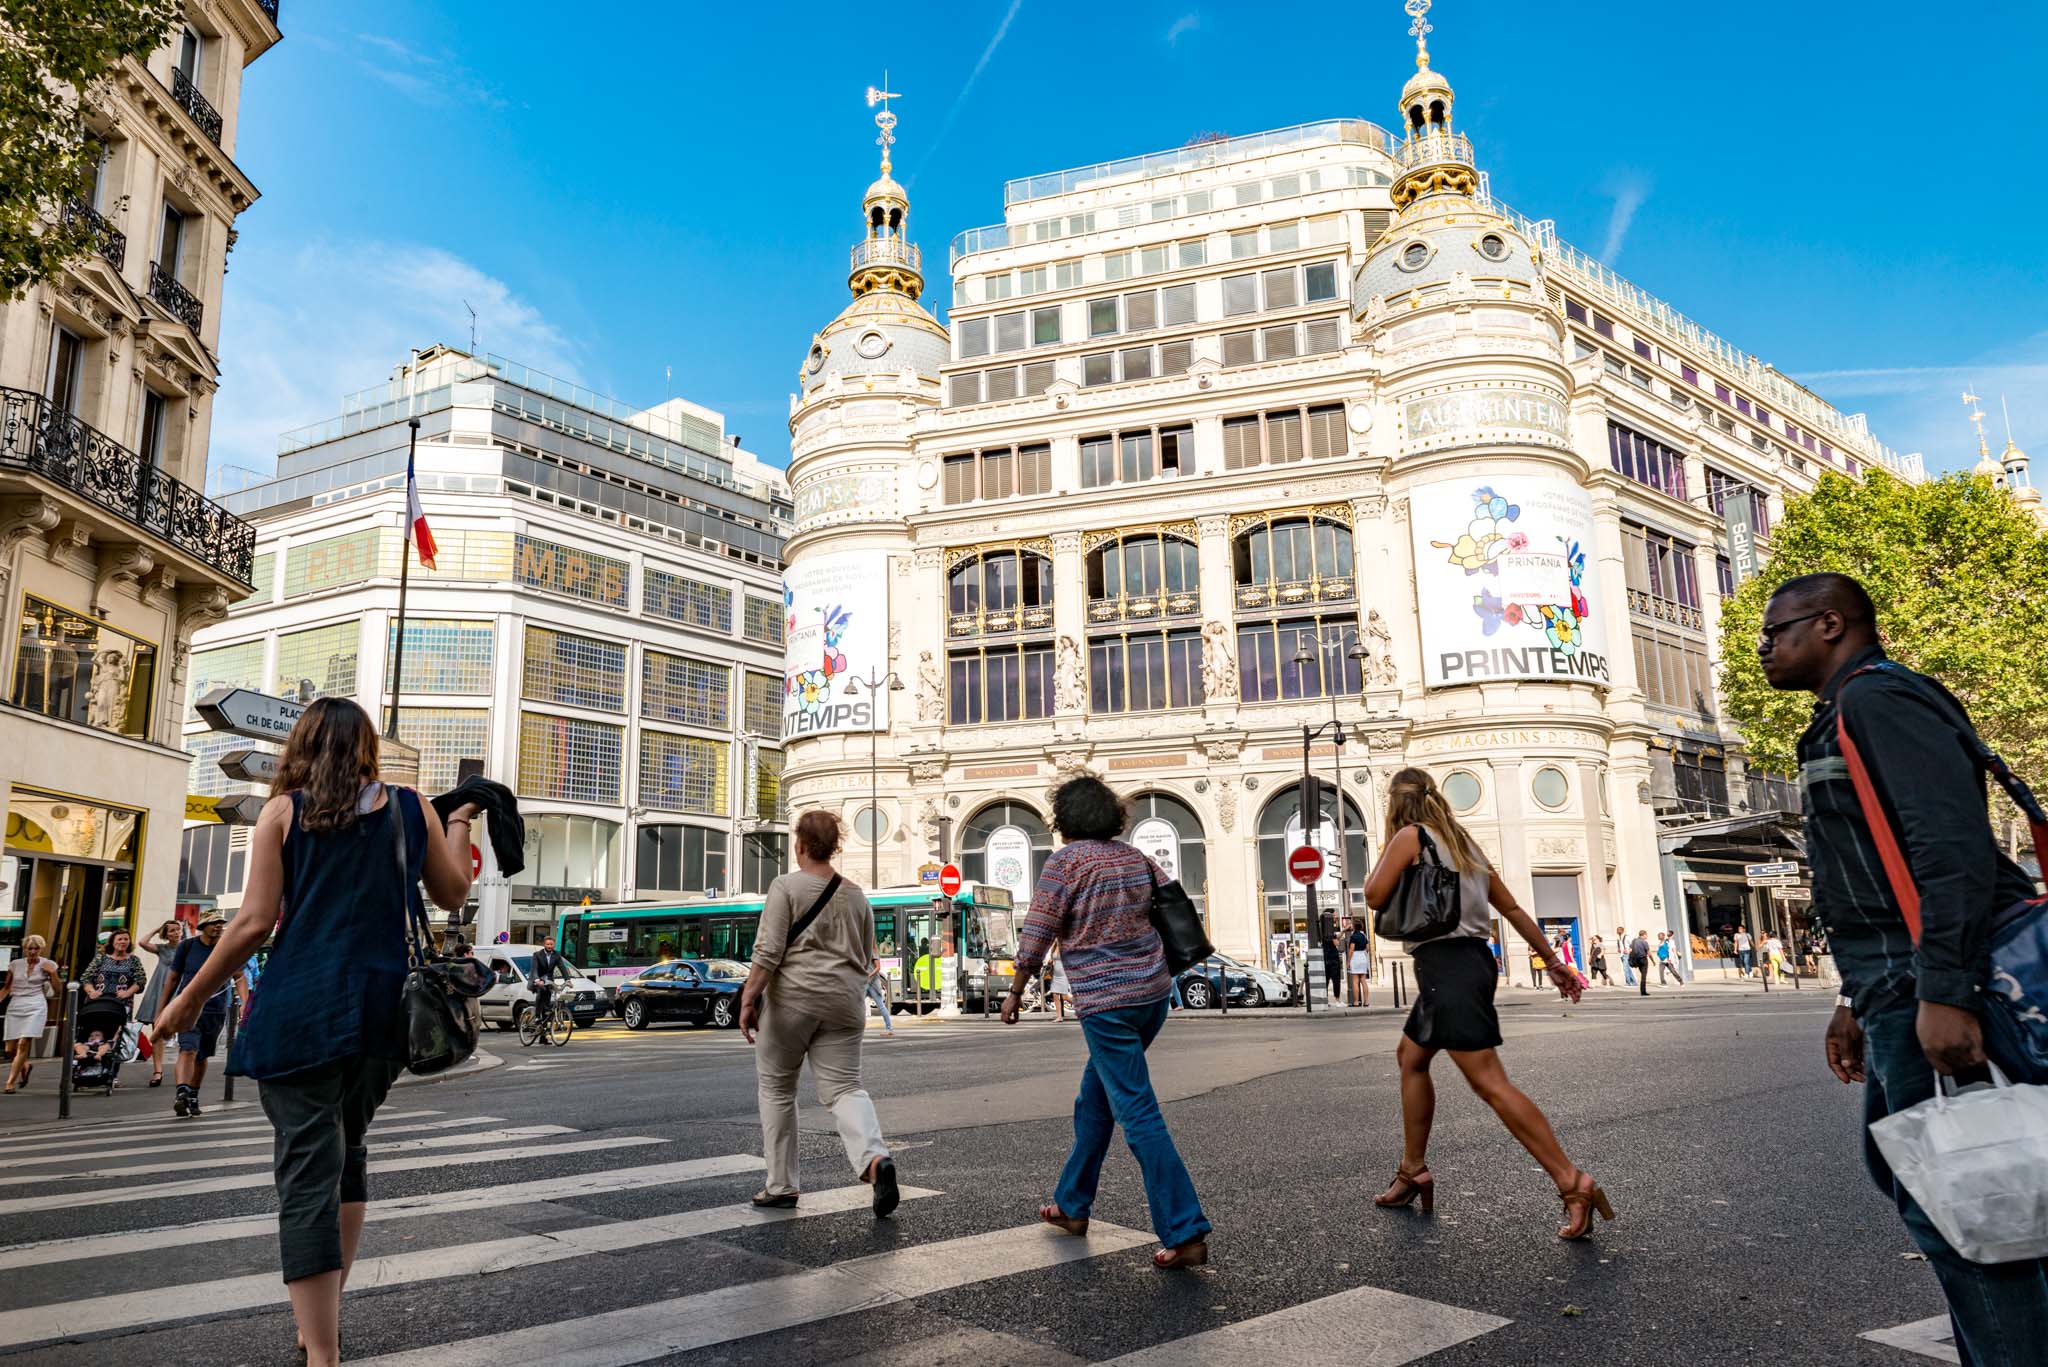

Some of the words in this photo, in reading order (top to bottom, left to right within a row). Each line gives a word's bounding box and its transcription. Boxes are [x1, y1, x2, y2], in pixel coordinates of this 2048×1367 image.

[1507, 556, 1562, 569] PRINTANIA
[1440, 647, 1610, 682] PRINTEMPS
[261, 716, 272, 729] DE
[1450, 731, 1541, 748] MAGASINS
[531, 887, 602, 901] PRINTEMPS
